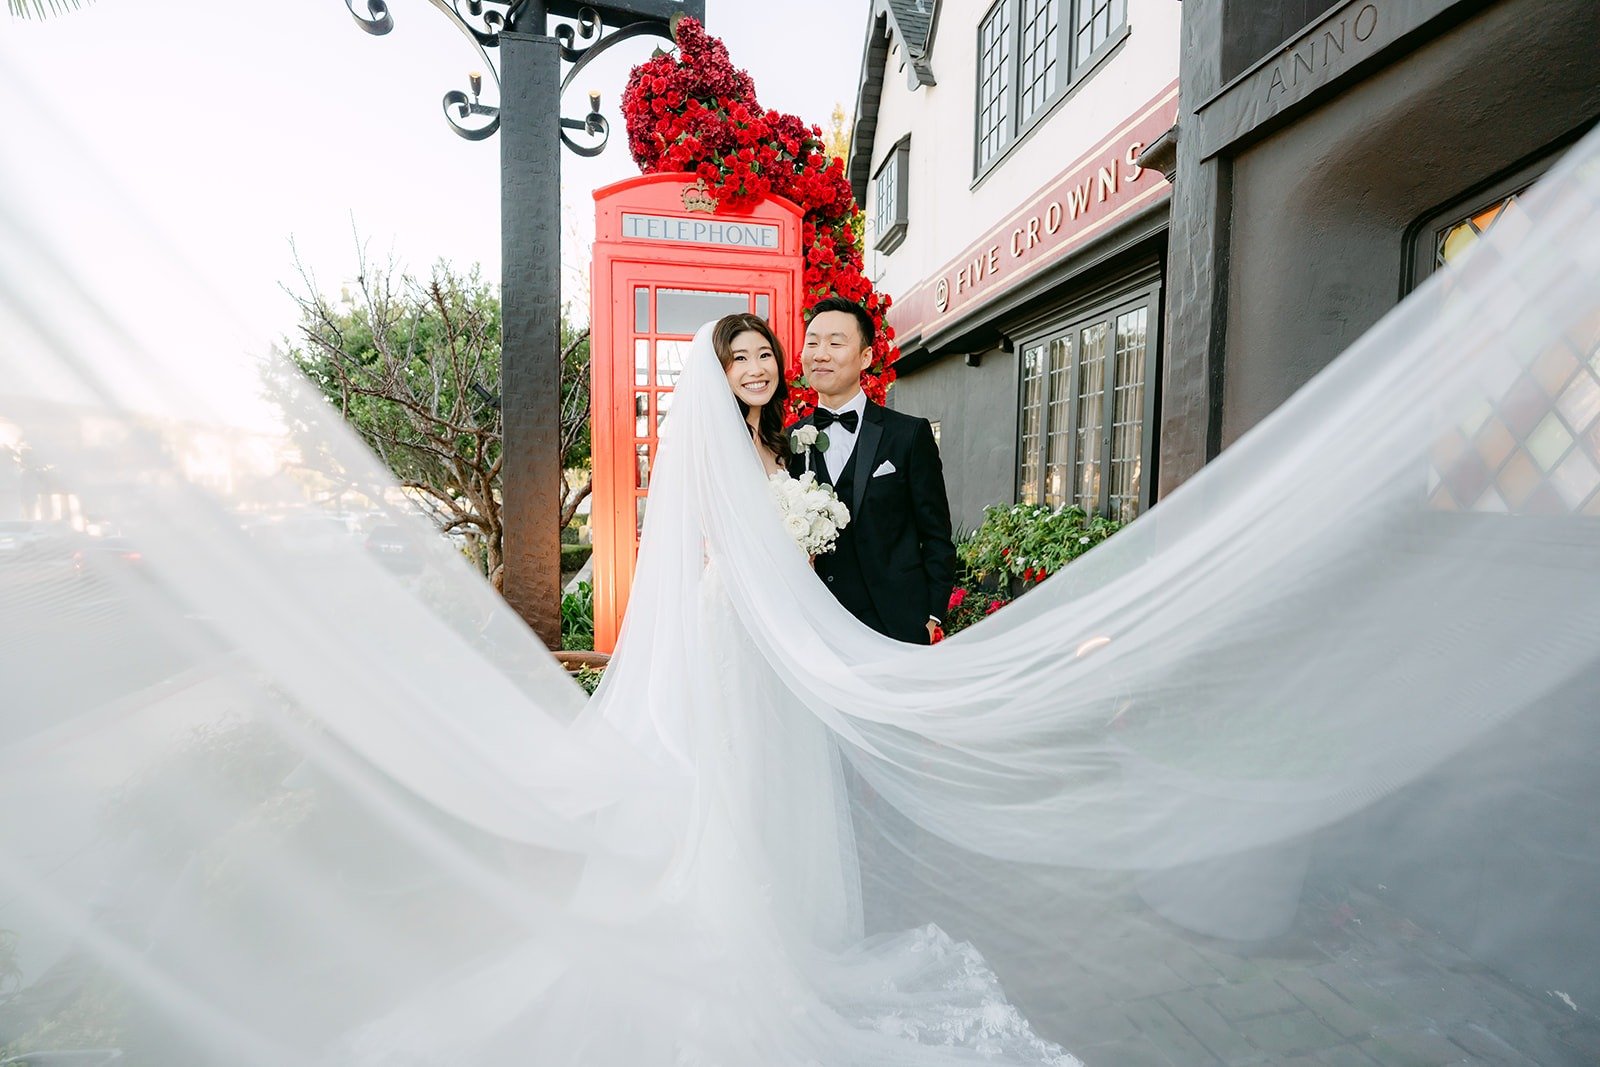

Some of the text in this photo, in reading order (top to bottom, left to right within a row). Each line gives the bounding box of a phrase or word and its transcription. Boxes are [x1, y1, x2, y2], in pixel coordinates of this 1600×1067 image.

[1266, 4, 1378, 102] ANNO
[628, 216, 773, 247] TELEPHONE
[955, 142, 1144, 295] FIVE CROWNS
